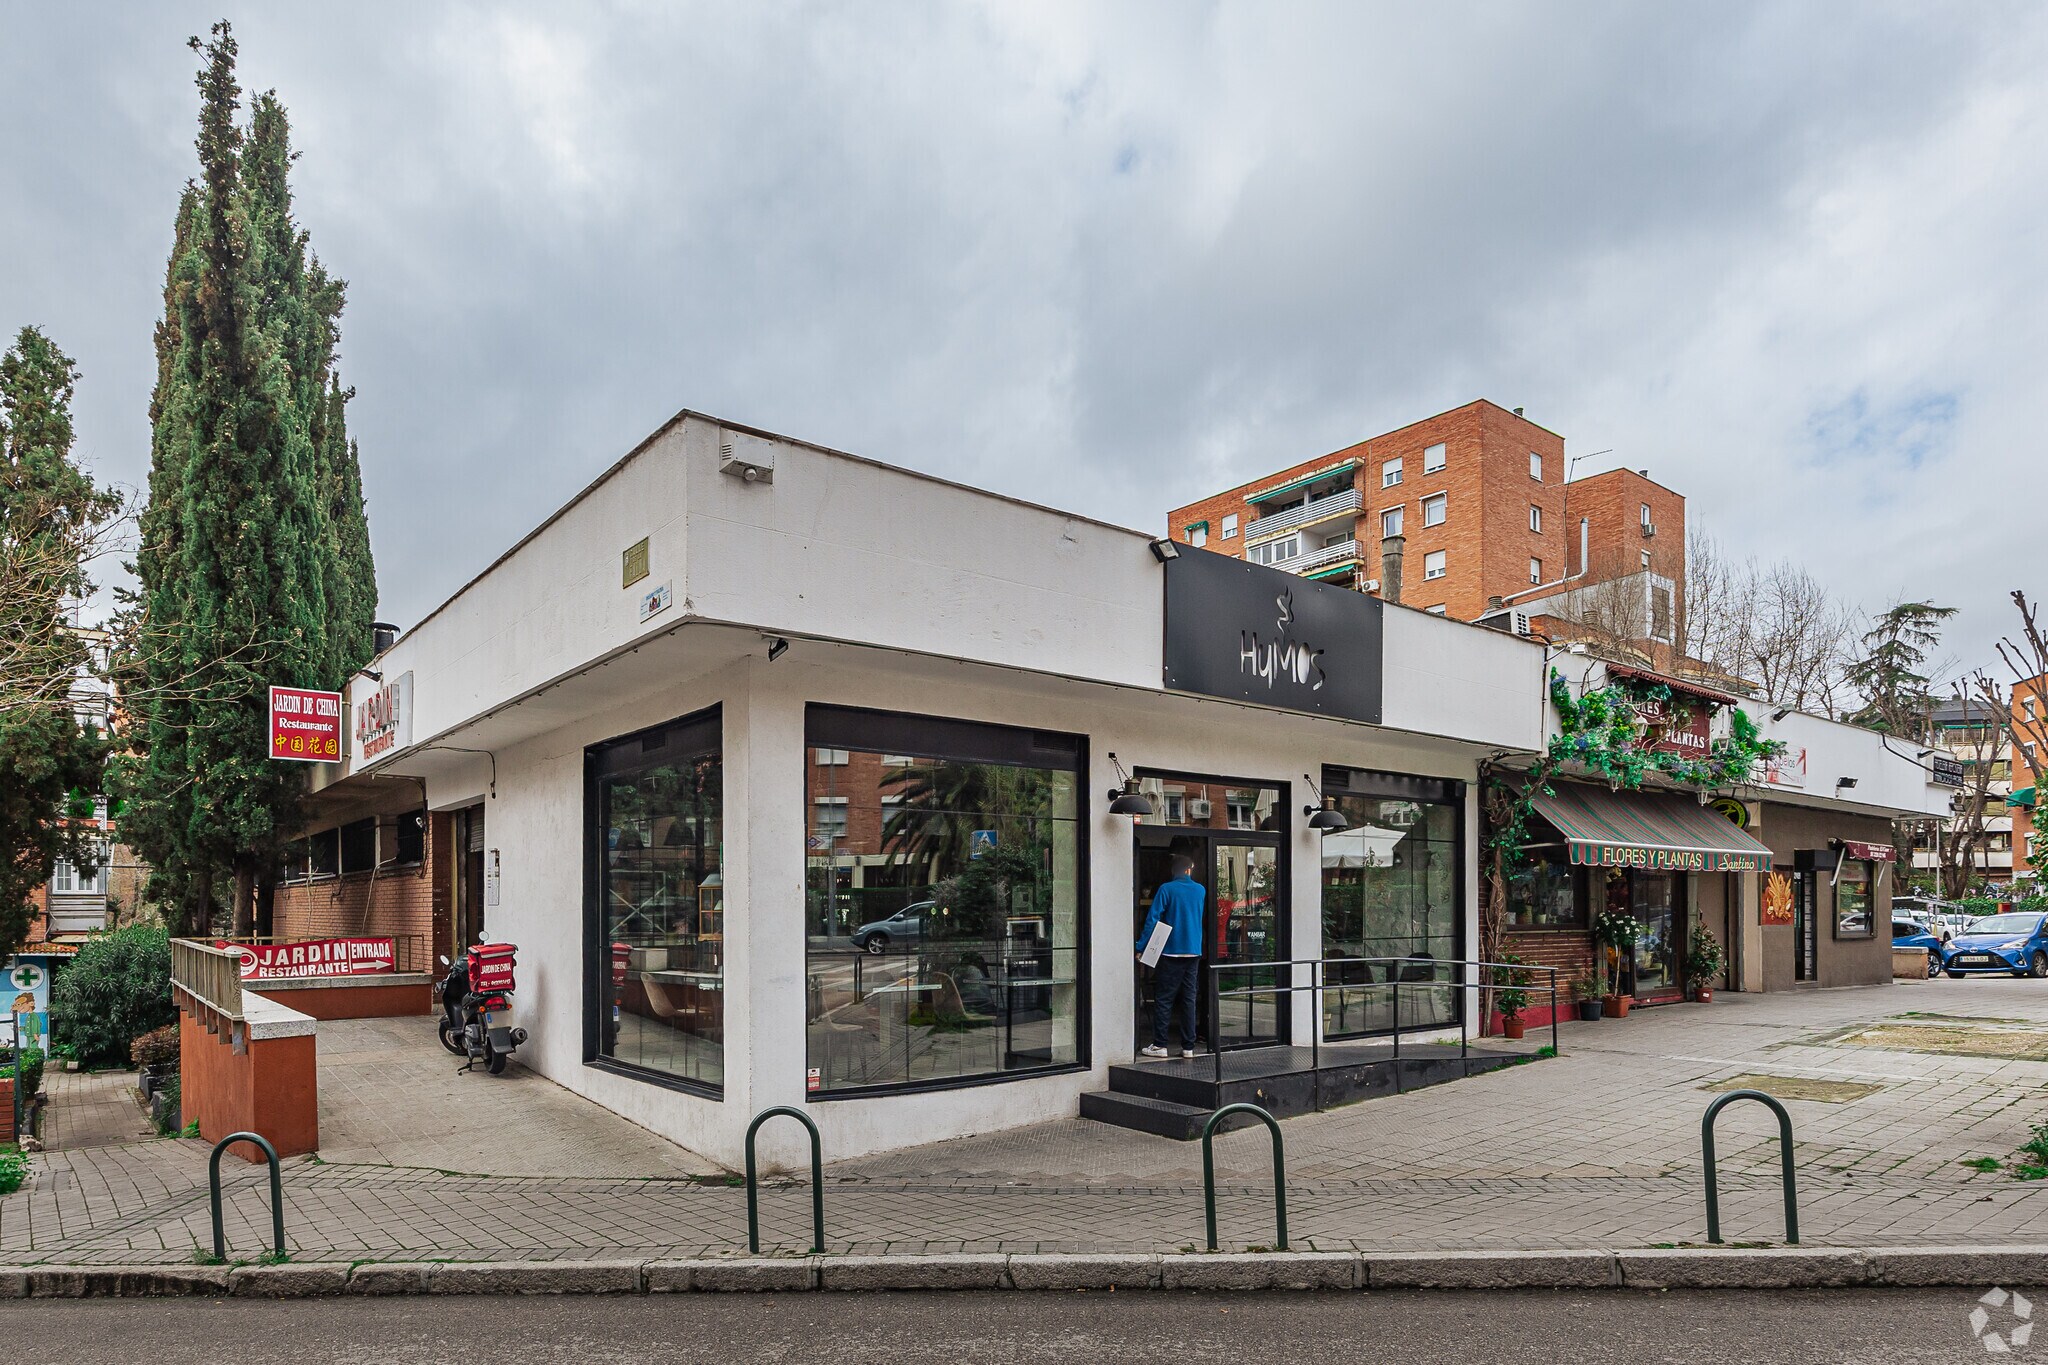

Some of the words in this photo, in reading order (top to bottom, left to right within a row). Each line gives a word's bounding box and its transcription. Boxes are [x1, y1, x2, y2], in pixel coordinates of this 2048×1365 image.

[273, 694, 301, 714] JARDIN
[302, 696, 314, 715] DE
[316, 697, 339, 717] CHINA
[278, 717, 334, 732] Restaurante
[274, 733, 338, 755] 中国花园
[1665, 728, 1705, 749] PLANTAS
[1603, 847, 1647, 864] FLORES
[1648, 849, 1657, 865] Y
[1658, 850, 1703, 867] PLANTAS
[1718, 853, 1755, 870] Santino
[259, 942, 347, 966] JARDIN
[351, 942, 391, 959] ENTRADA
[258, 962, 349, 978] RESTAURANTE
[481, 964, 495, 974] JARDIN
[494, 964, 500, 973] DE
